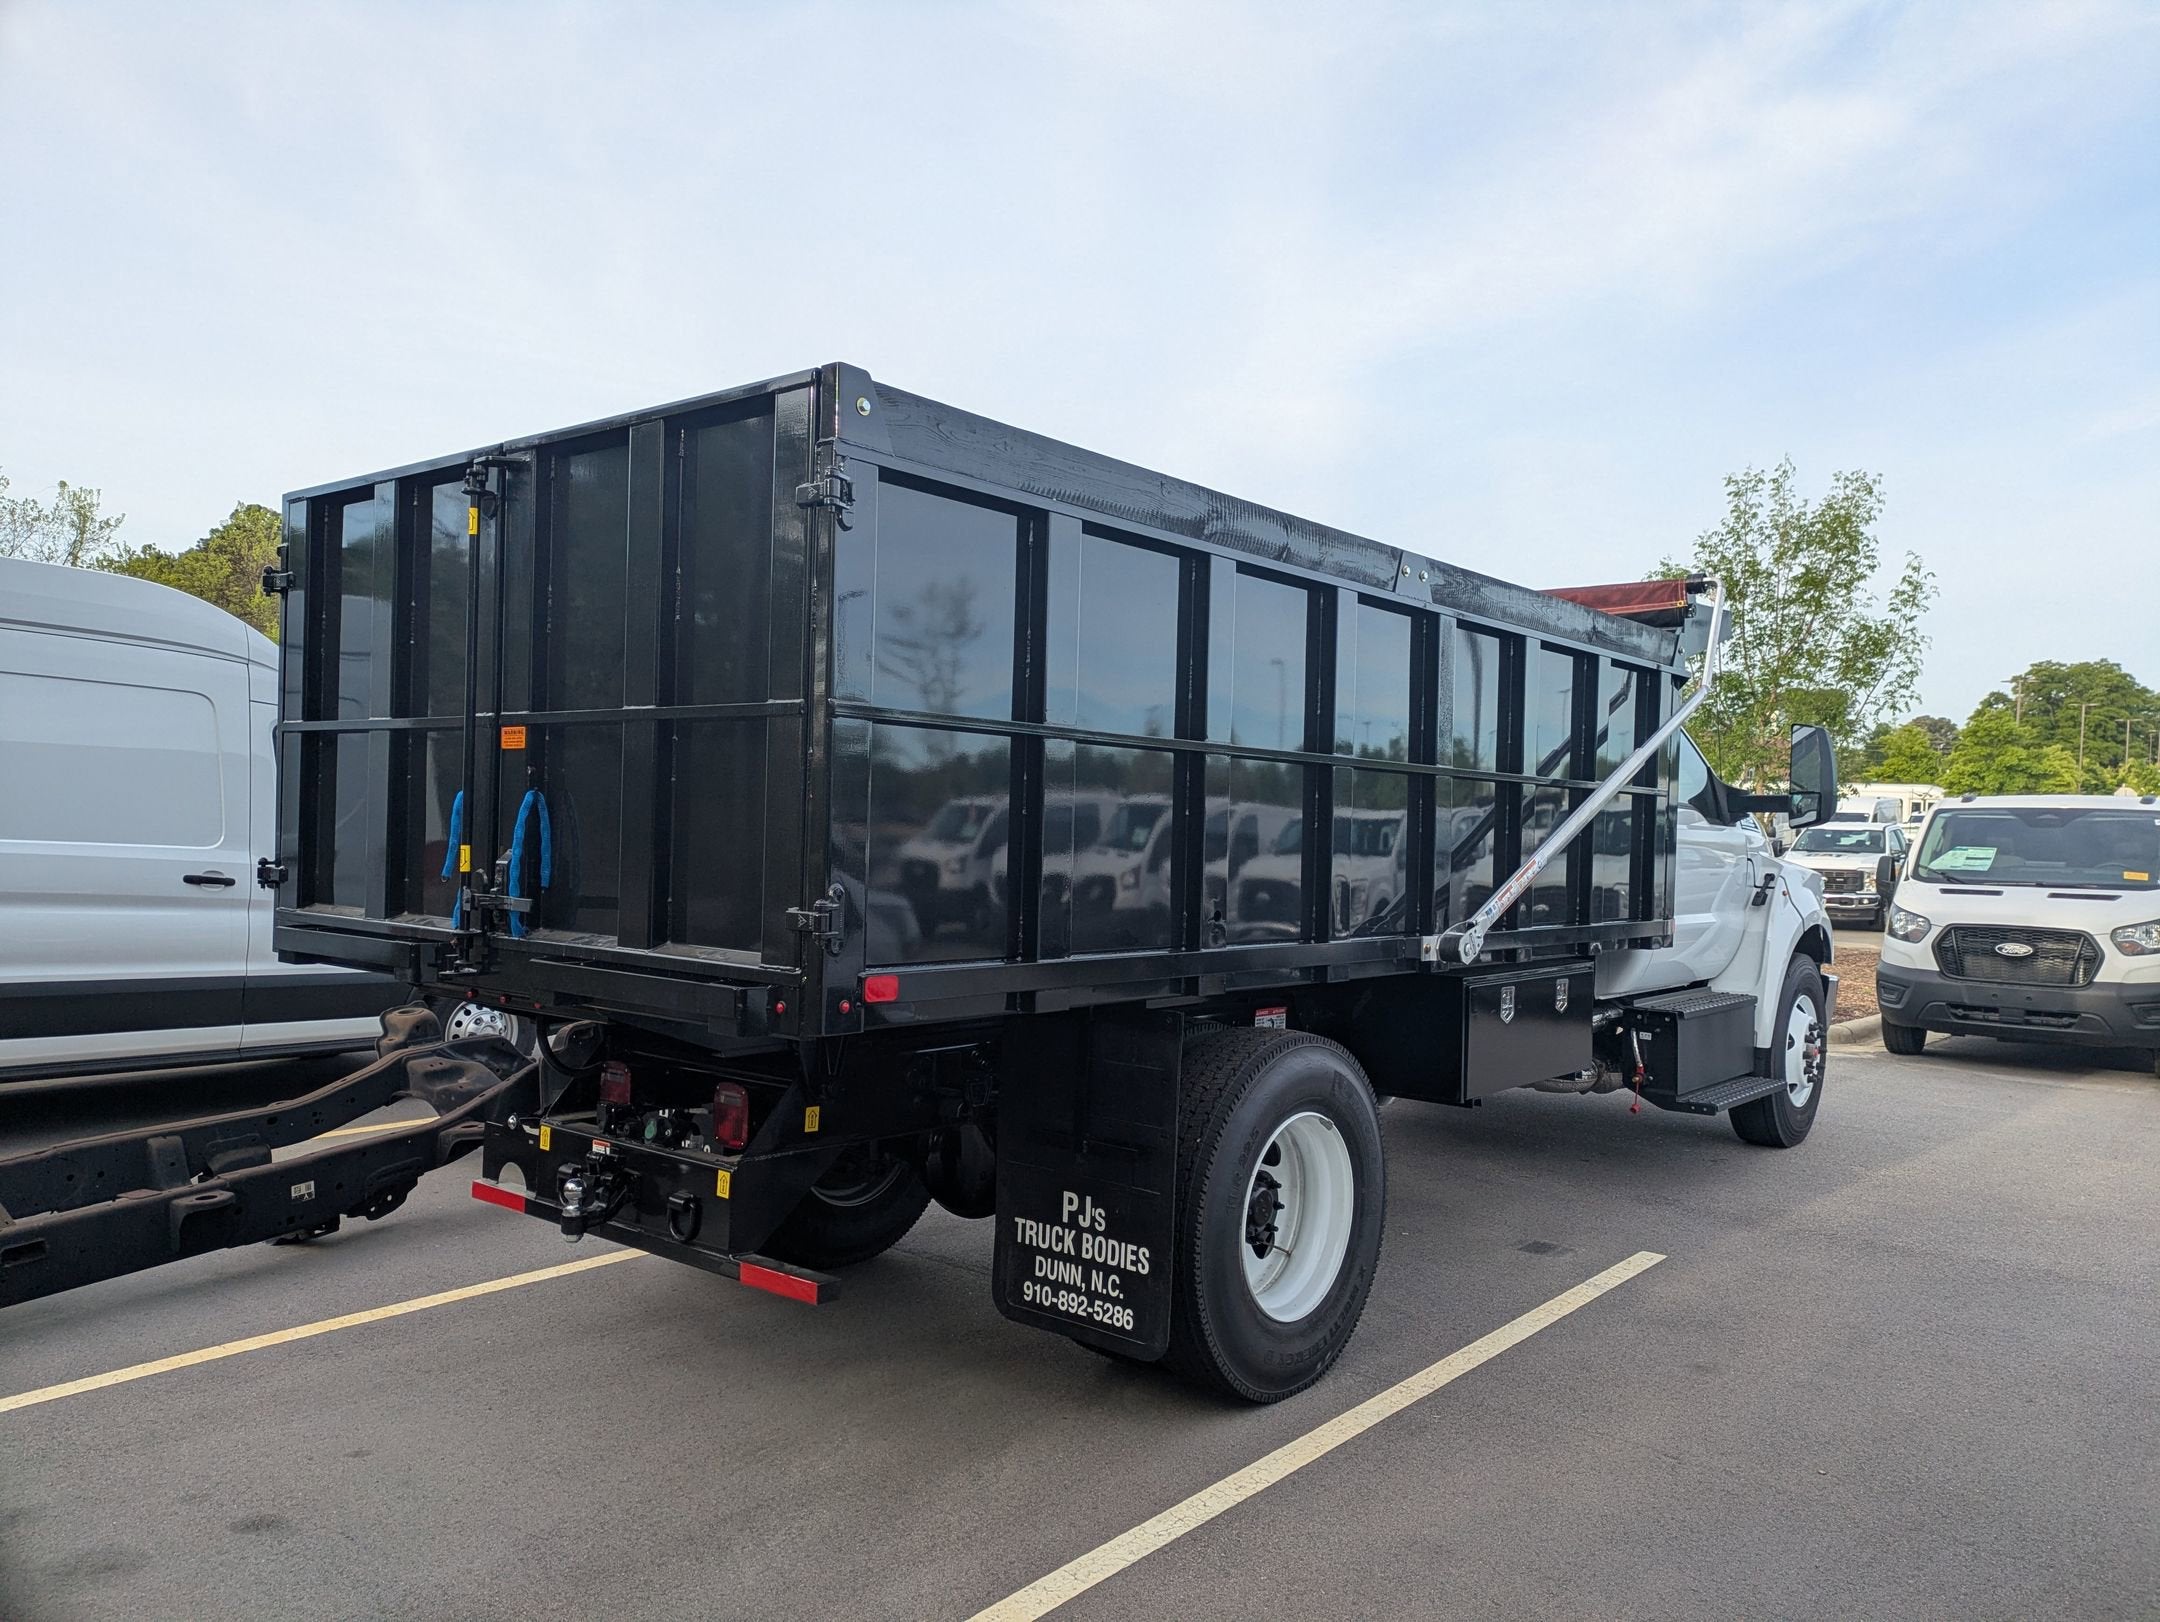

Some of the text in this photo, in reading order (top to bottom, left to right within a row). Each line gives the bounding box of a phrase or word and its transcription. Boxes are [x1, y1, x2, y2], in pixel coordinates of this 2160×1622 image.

[1014, 1217, 1150, 1275] TRUCK BODIES
[1034, 1255, 1124, 1299] DUNN, N.C.
[1023, 1281, 1134, 1330] 910-892-5286
